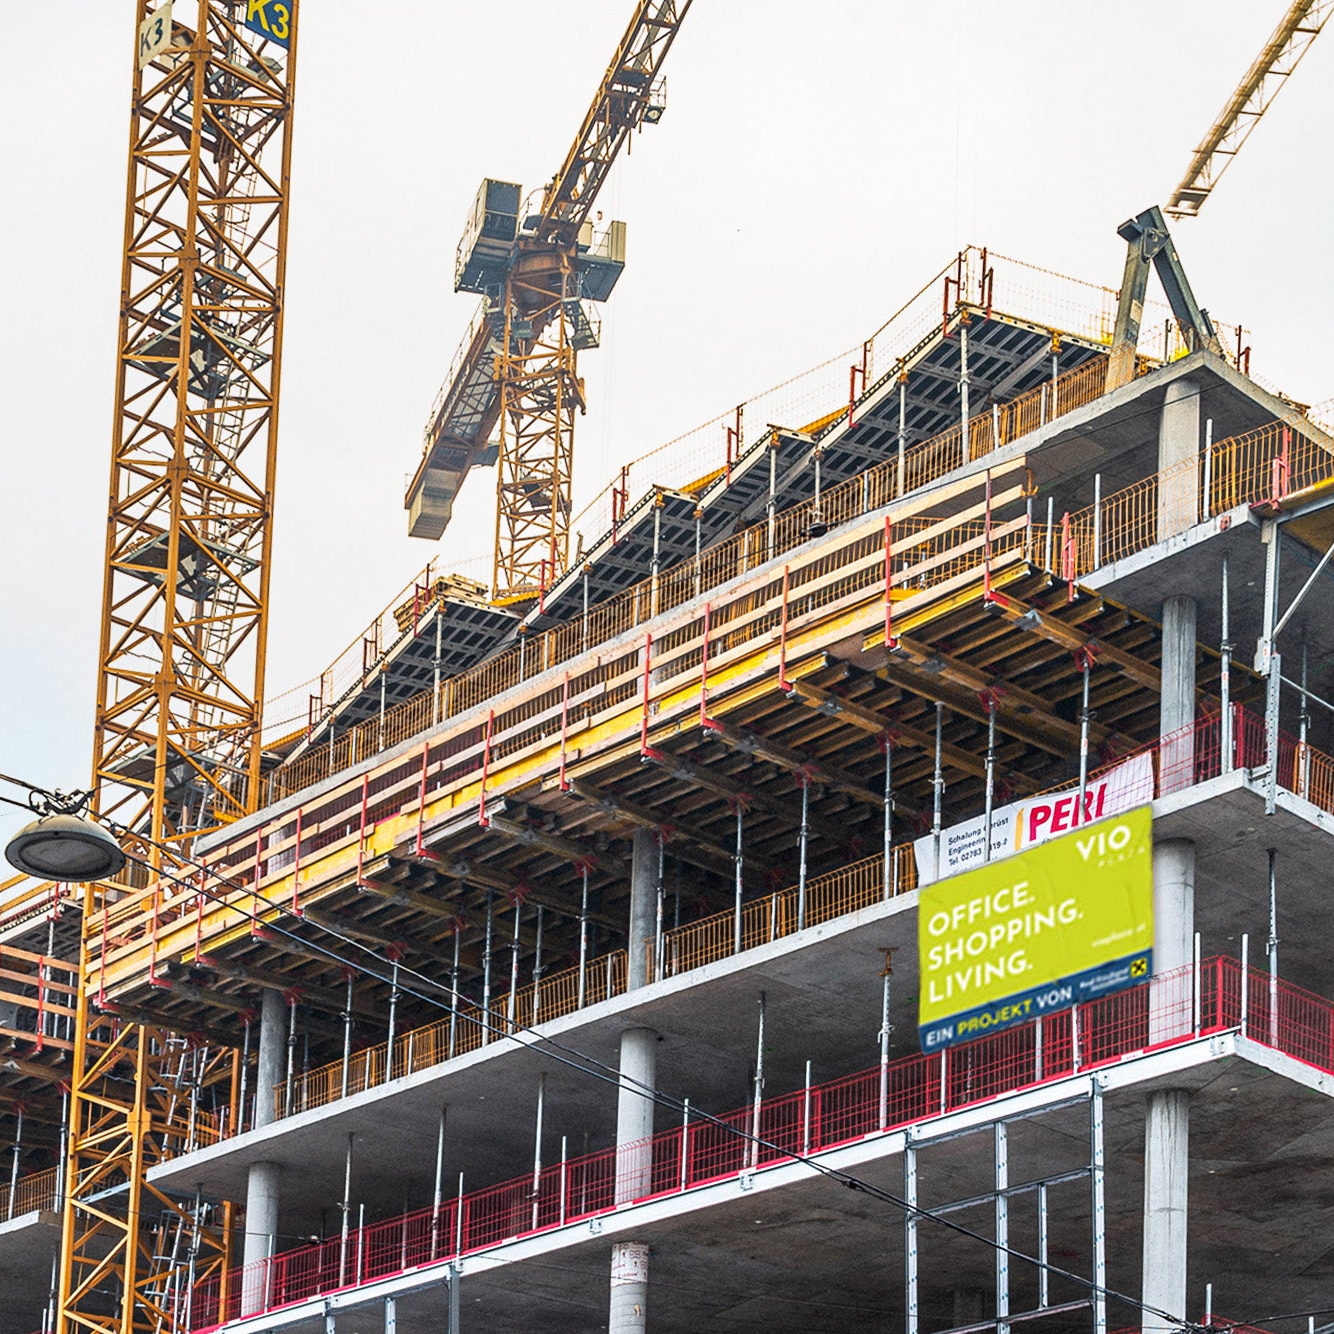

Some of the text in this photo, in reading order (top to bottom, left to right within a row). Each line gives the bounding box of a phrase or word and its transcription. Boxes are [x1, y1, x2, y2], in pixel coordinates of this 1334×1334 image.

[141, 17, 164, 57] K3
[247, 0, 290, 39] K3
[1028, 782, 1107, 842] PERI
[948, 837, 986, 857] Engineerin
[1075, 825, 1131, 861] VIO
[928, 881, 1036, 937] OFFICE.
[928, 898, 1084, 971] SHOPPING.
[929, 950, 1034, 1004] LIVING.
[925, 986, 1073, 1047] EIN PROJEKT VON
